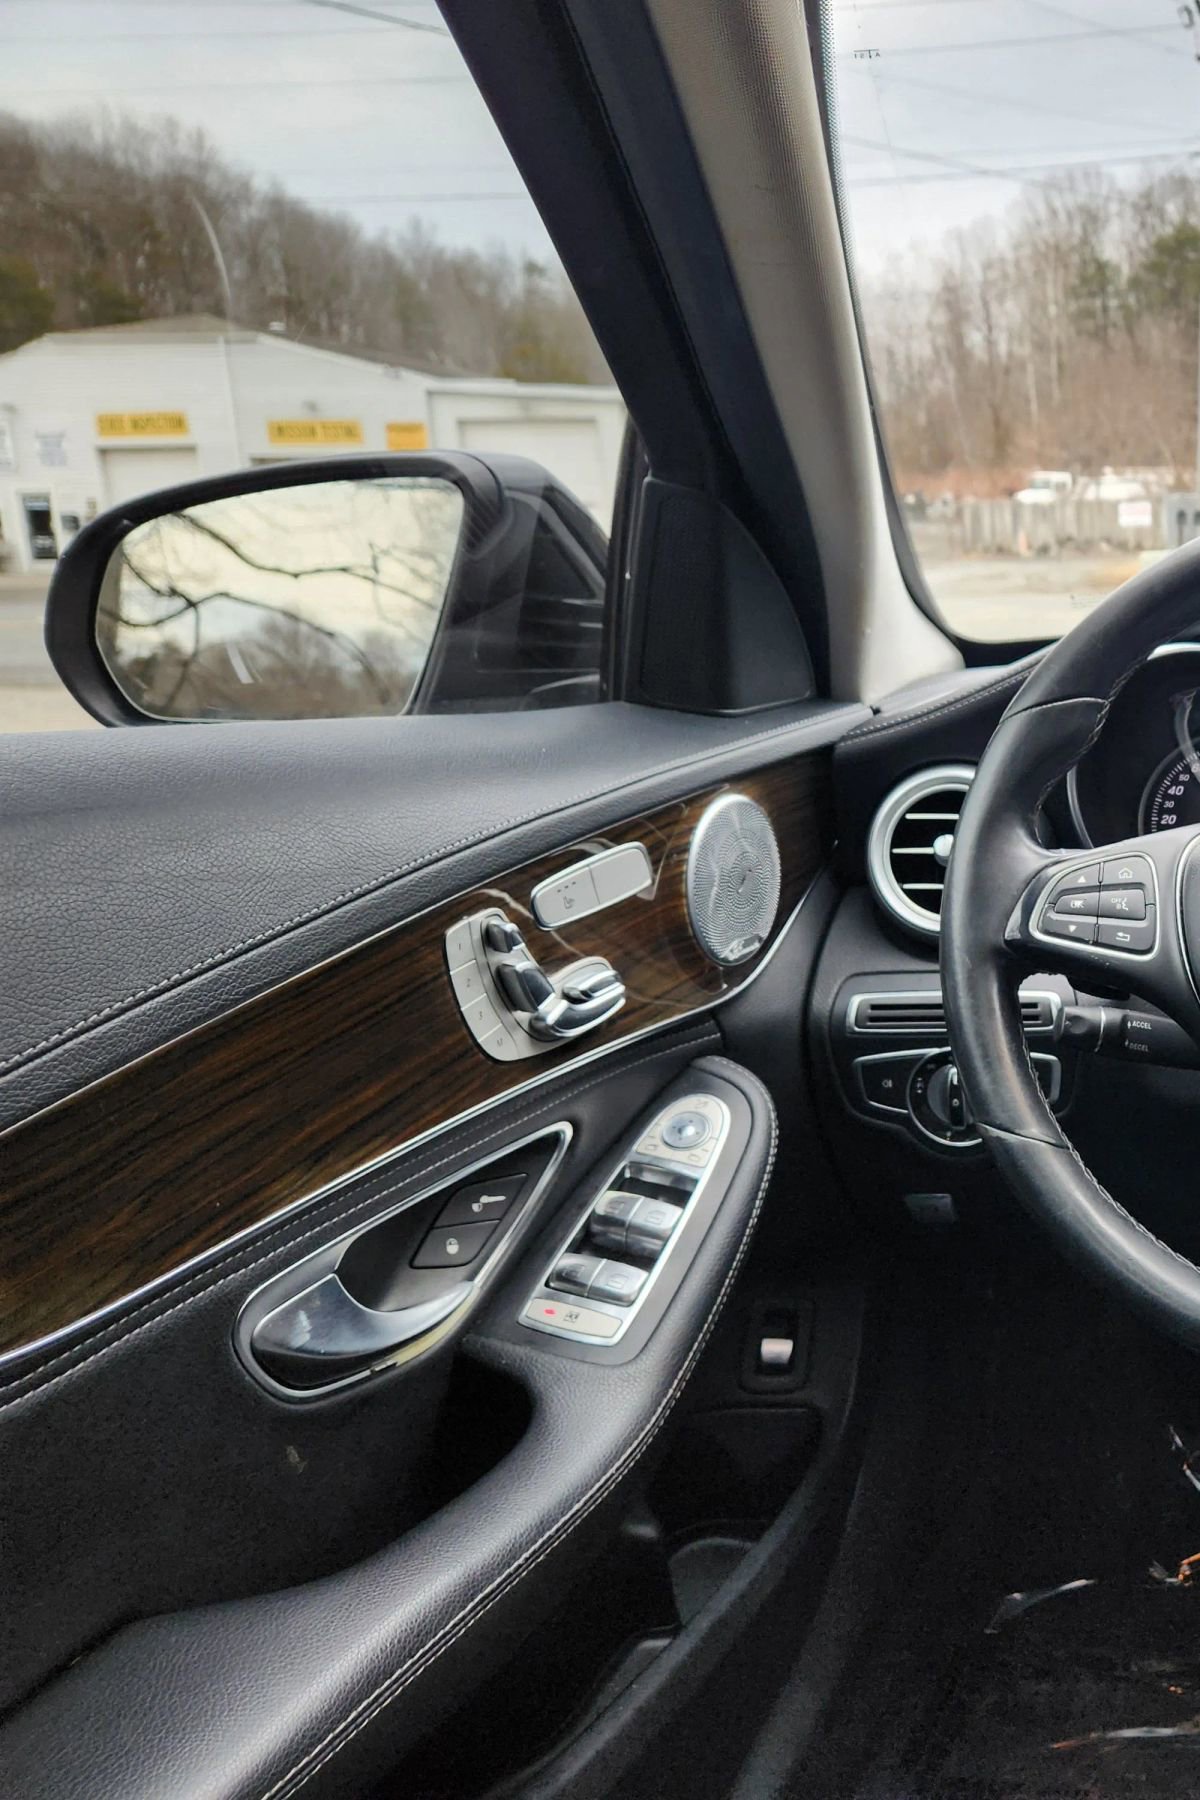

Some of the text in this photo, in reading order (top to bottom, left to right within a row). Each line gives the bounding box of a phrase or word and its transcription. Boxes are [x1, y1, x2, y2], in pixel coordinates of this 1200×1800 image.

[1168, 786, 1184, 796] 40
[1160, 815, 1177, 825] 20
[1132, 1020, 1152, 1030] ACCEL
